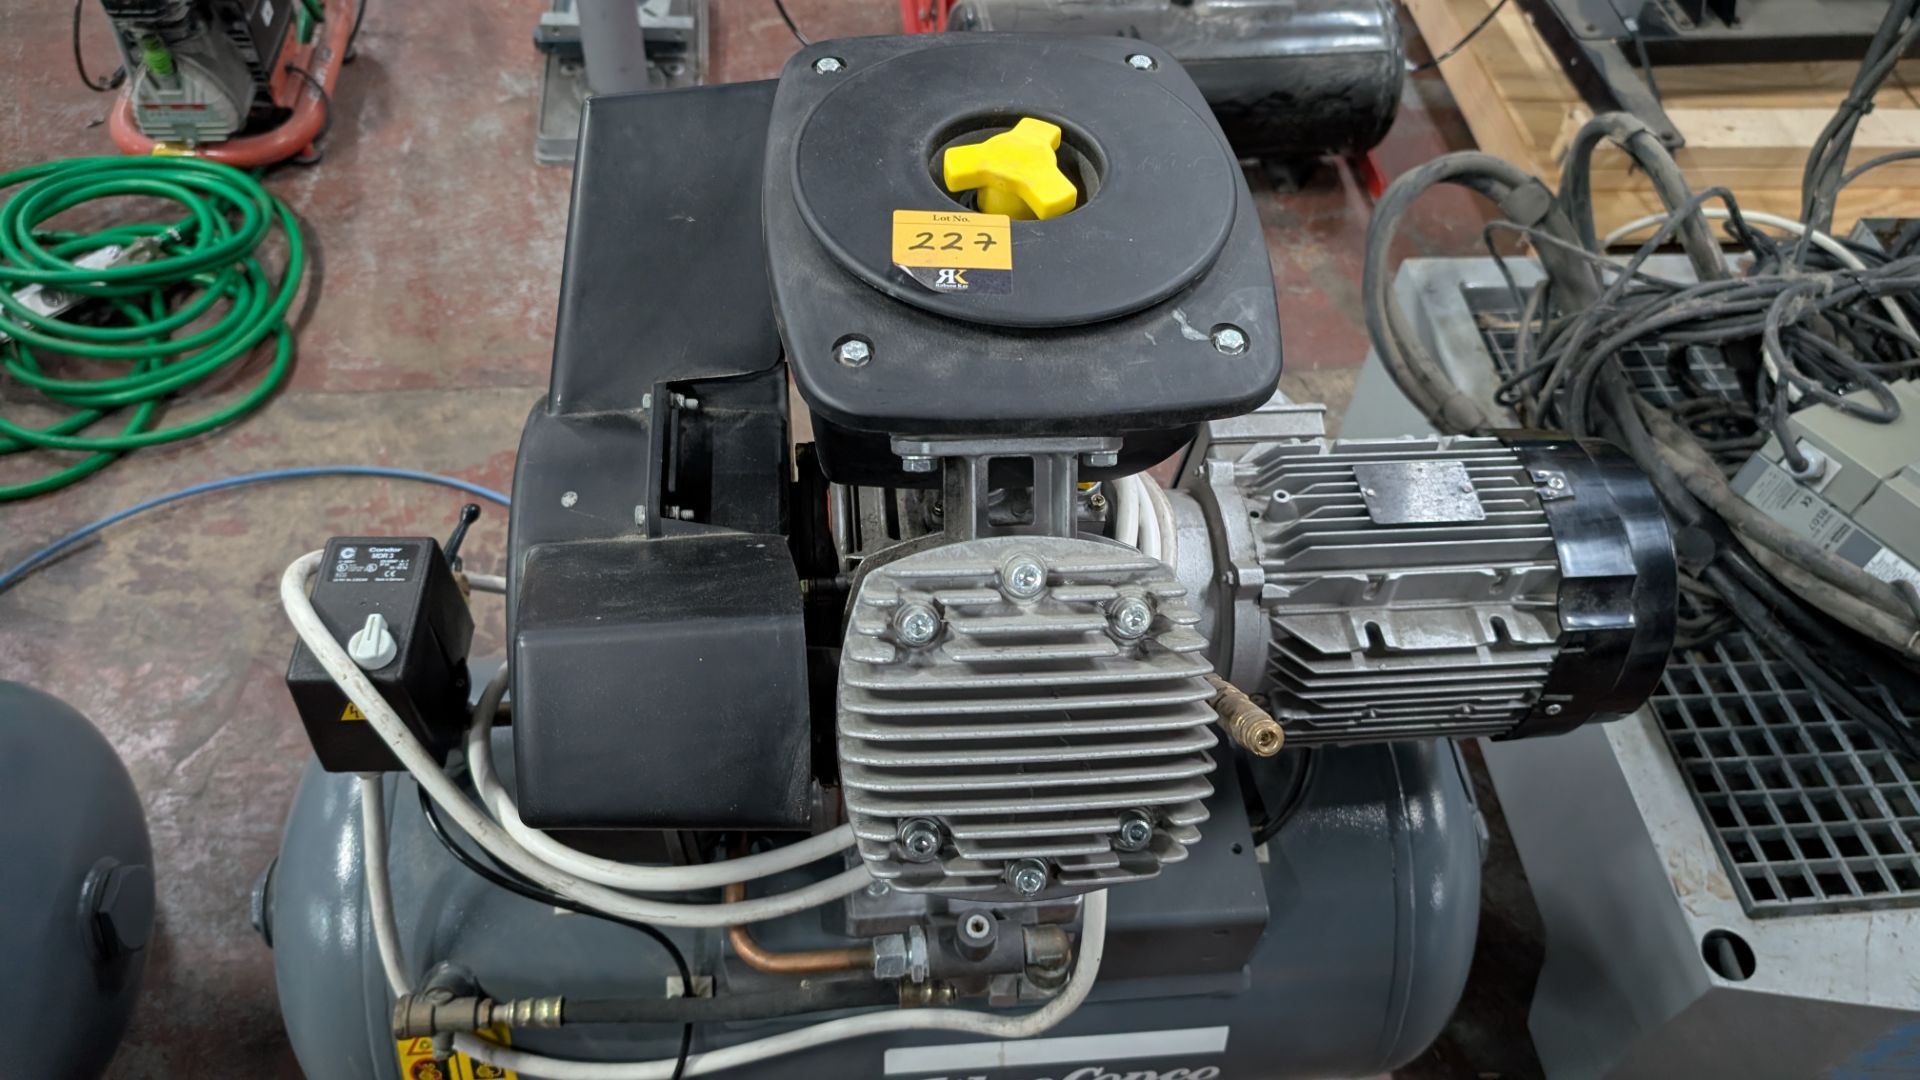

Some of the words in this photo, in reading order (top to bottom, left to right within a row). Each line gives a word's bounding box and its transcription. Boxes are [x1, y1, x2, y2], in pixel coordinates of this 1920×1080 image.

[933, 214, 950, 222] Lot
[953, 215, 970, 223] No.
[908, 232, 997, 252] 227
